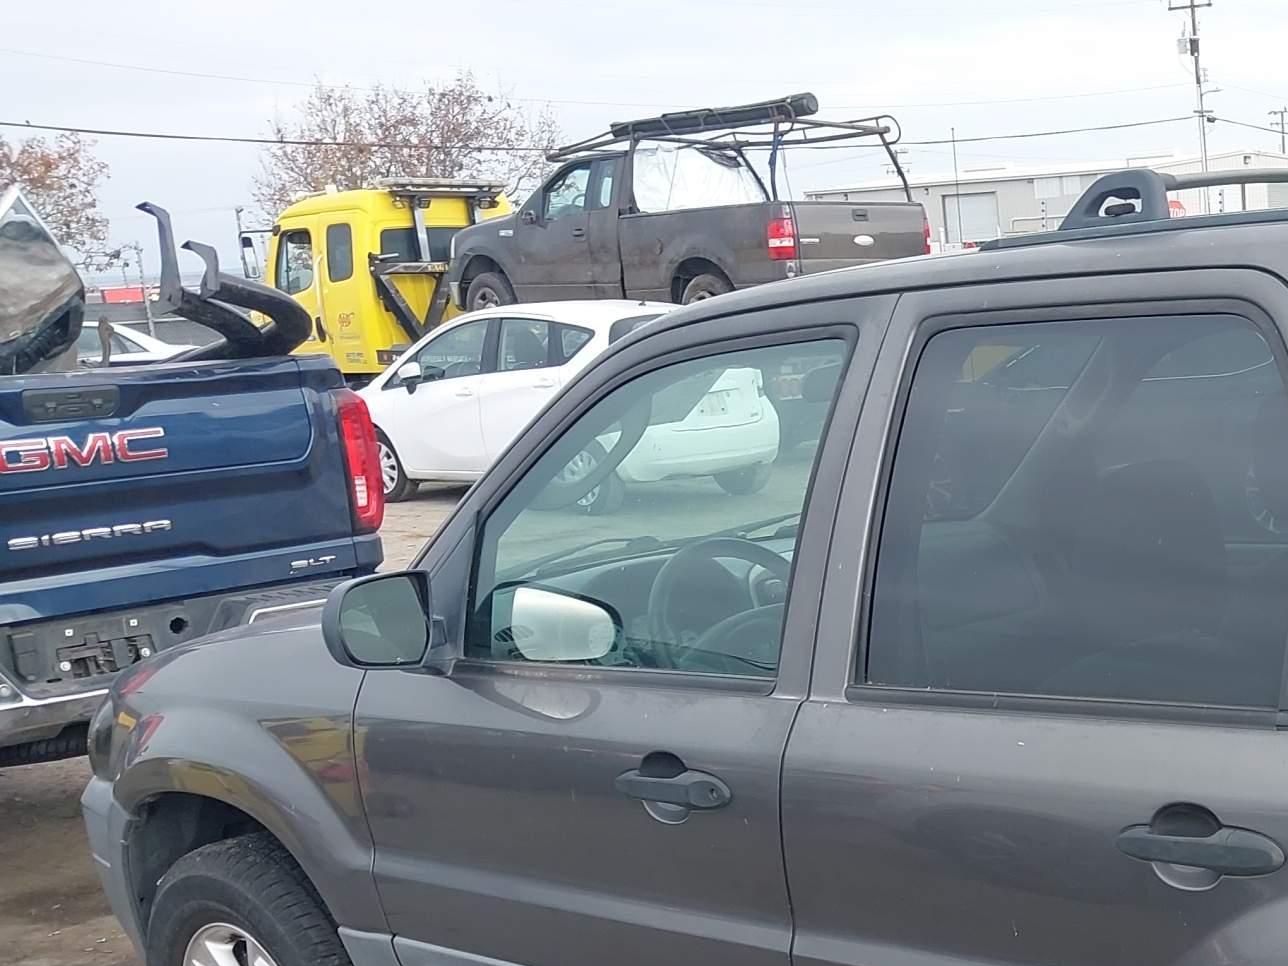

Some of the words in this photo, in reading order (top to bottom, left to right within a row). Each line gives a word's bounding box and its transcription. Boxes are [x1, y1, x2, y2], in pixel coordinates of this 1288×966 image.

[0, 427, 168, 474] GMC
[7, 518, 172, 551] SIERRA
[289, 554, 337, 572] SLT
